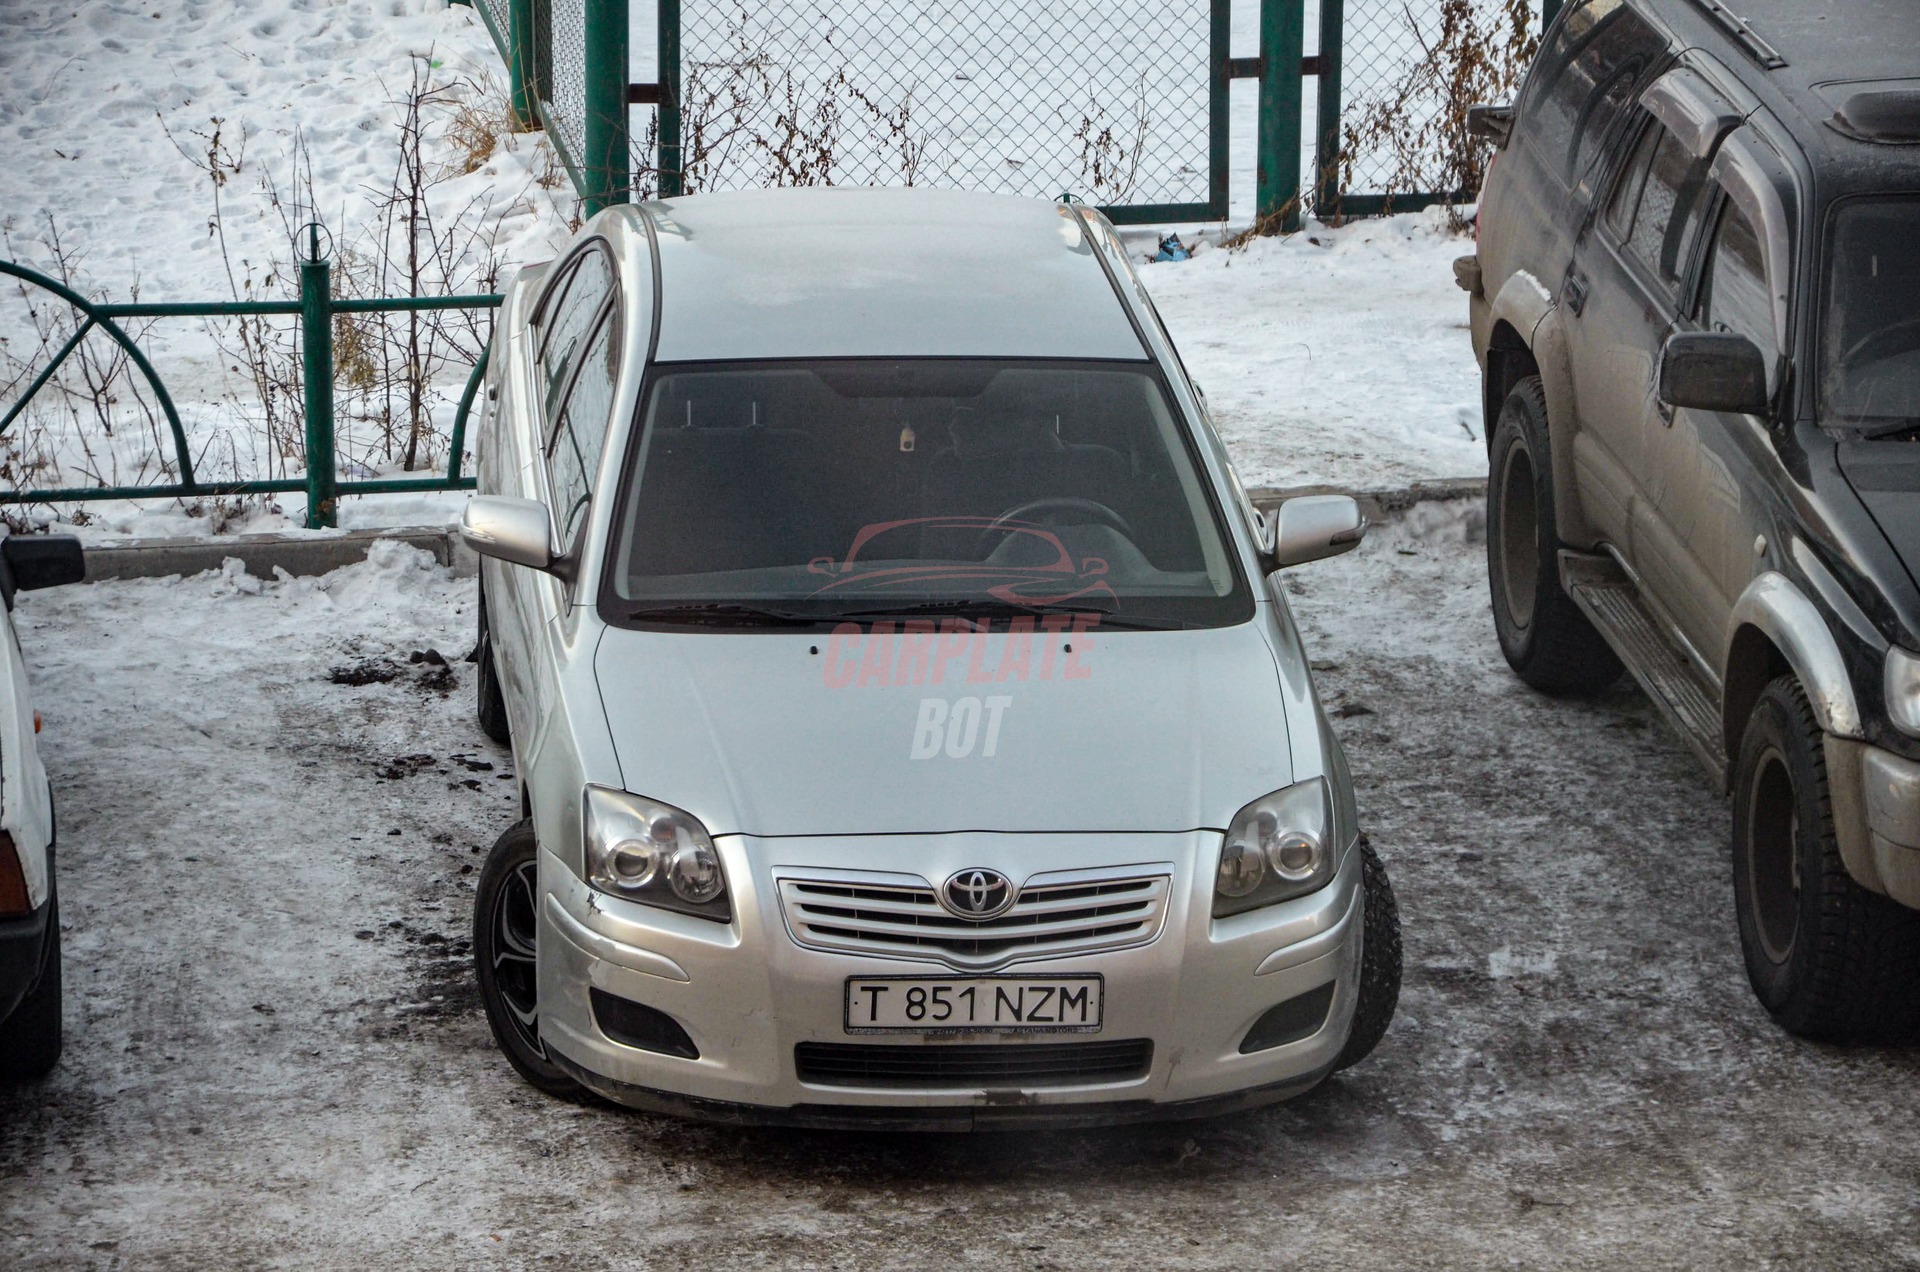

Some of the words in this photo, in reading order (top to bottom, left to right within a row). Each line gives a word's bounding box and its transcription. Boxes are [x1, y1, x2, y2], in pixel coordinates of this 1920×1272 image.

[860, 986, 889, 1021] T
[905, 986, 976, 1021] 851
[995, 986, 1088, 1022] NZM
